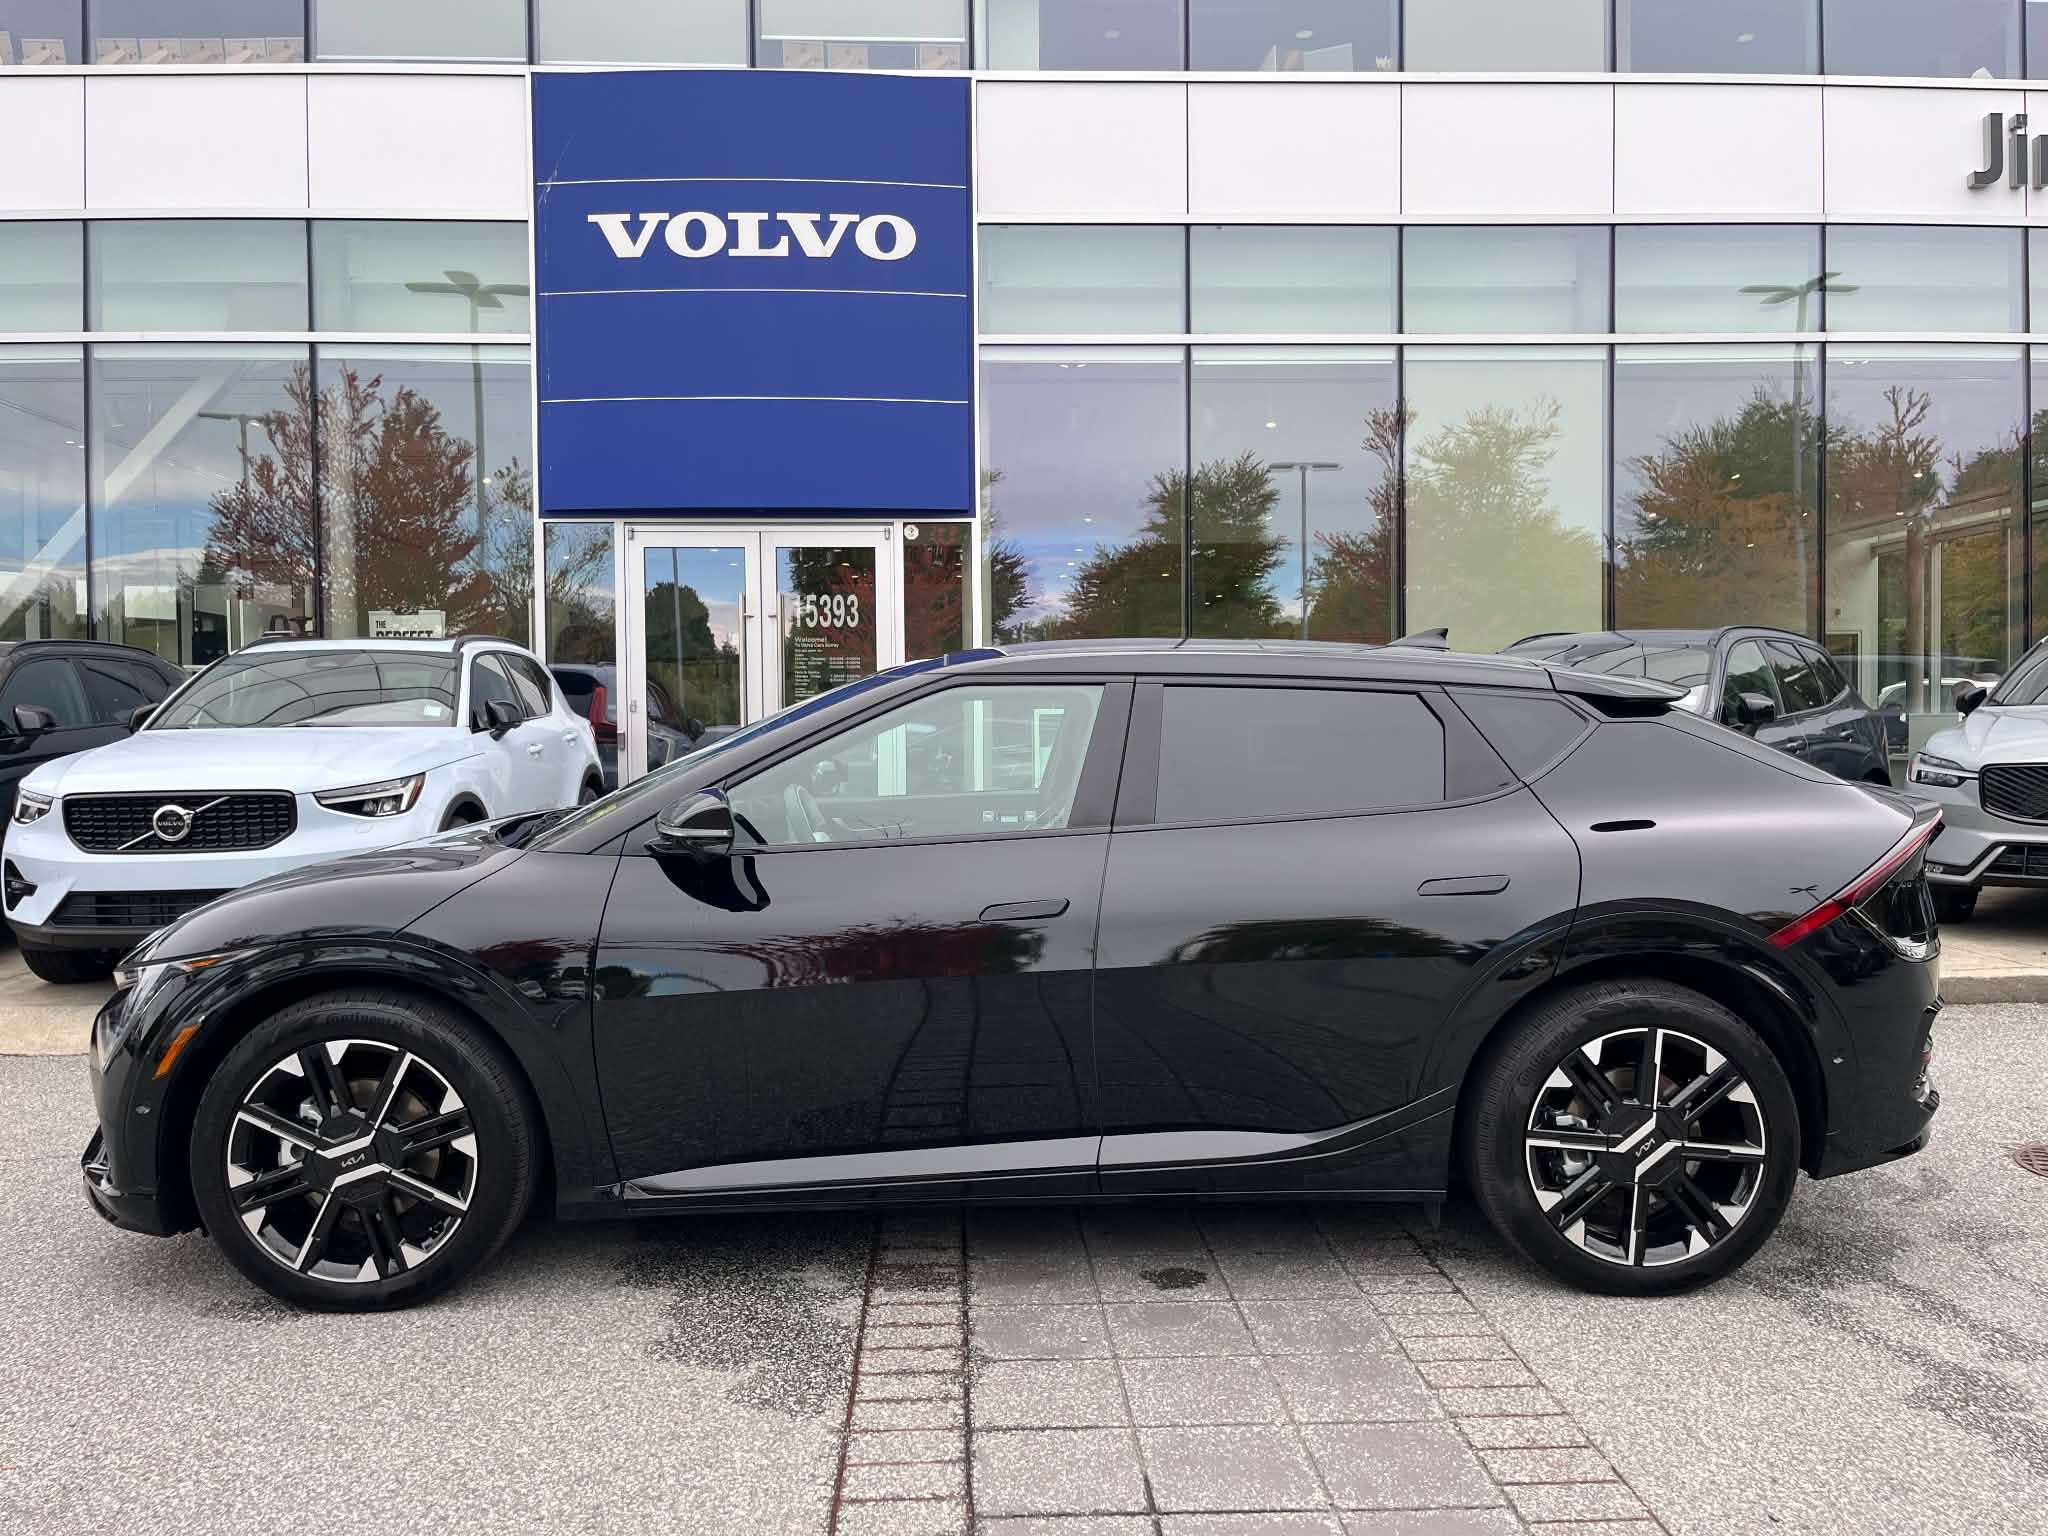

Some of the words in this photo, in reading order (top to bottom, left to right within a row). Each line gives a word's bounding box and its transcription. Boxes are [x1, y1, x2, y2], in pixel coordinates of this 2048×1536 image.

[1967, 112, 2048, 190] Ji
[587, 211, 917, 261] VOLVO
[376, 620, 386, 628] THE
[793, 594, 860, 628] 15393
